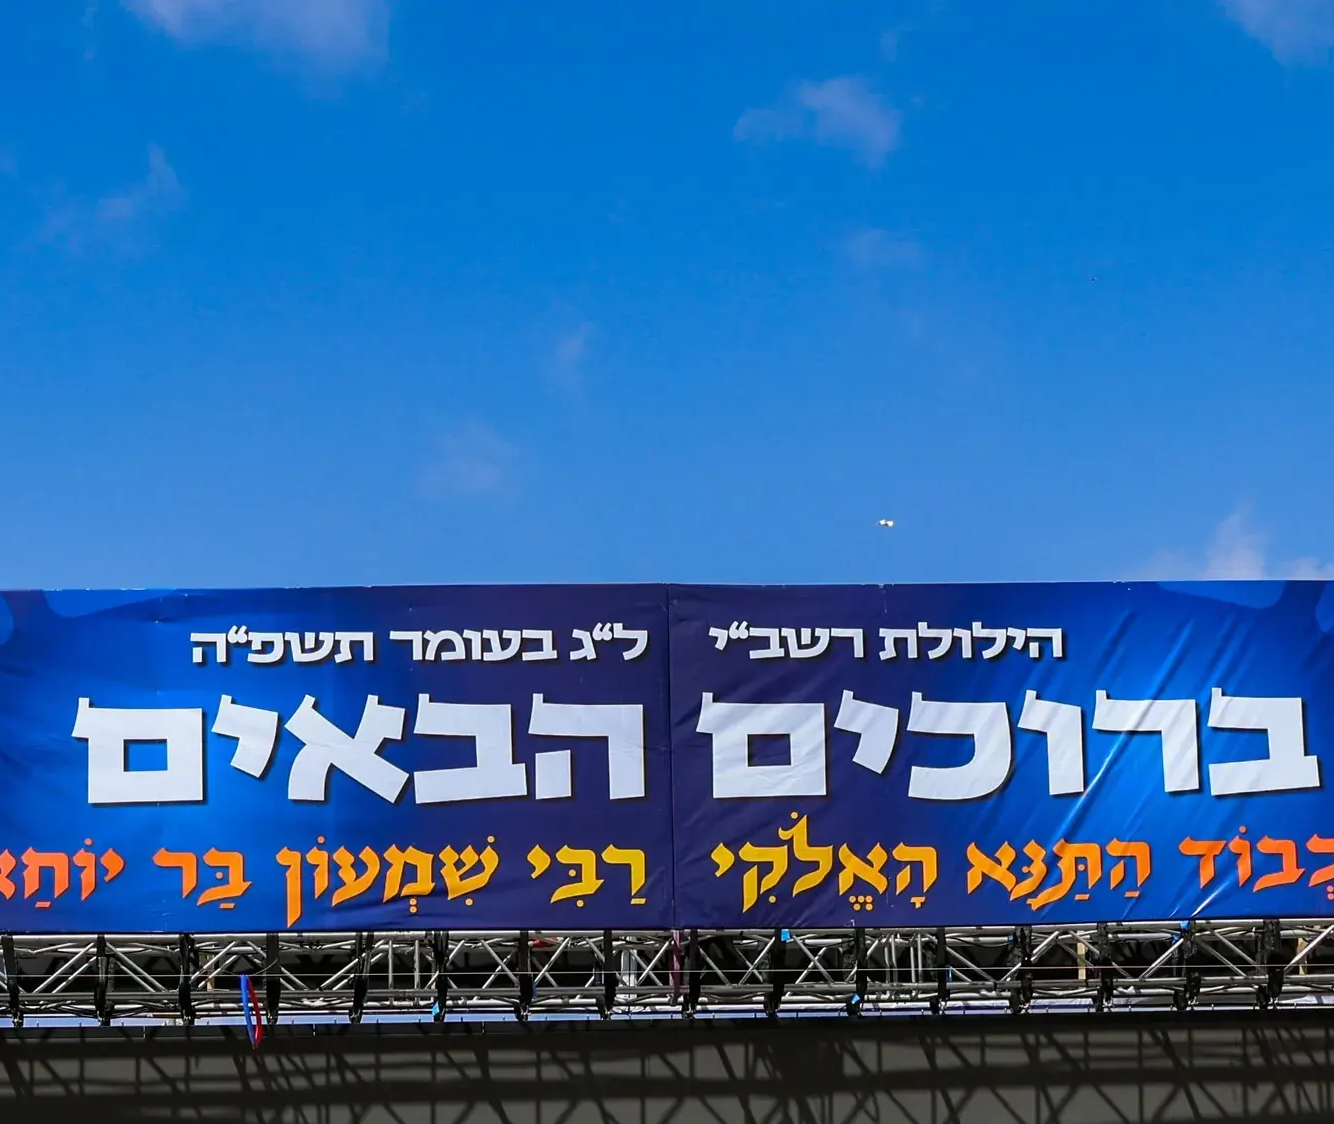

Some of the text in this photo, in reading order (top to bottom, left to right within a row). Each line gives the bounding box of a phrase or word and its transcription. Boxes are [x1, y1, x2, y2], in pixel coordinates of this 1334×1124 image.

[389, 627, 558, 662] בעומר
[879, 622, 1063, 661] הילולת
[72, 687, 1320, 804] ברוכים הבאים
